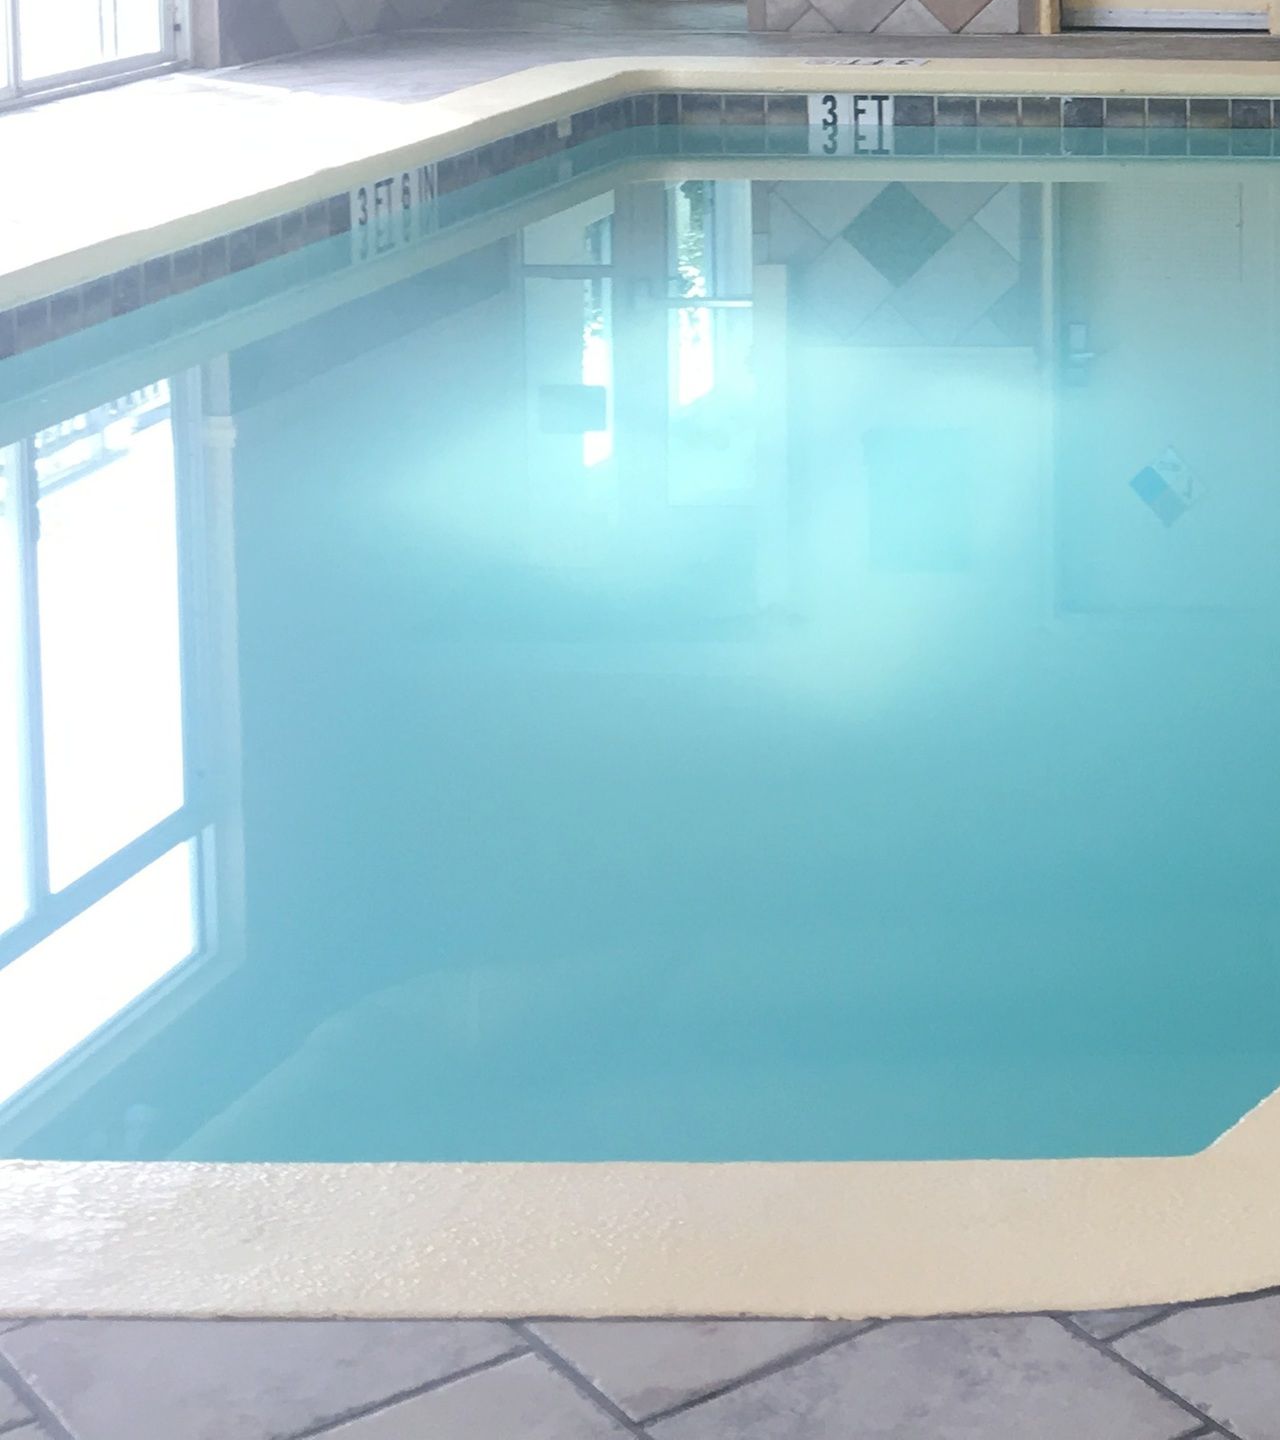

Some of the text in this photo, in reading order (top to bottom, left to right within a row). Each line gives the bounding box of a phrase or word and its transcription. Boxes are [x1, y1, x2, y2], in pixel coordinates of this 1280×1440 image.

[822, 94, 890, 126] 3 FT
[357, 186, 368, 226] 3
[374, 177, 394, 217] FT
[418, 163, 436, 203] IN
